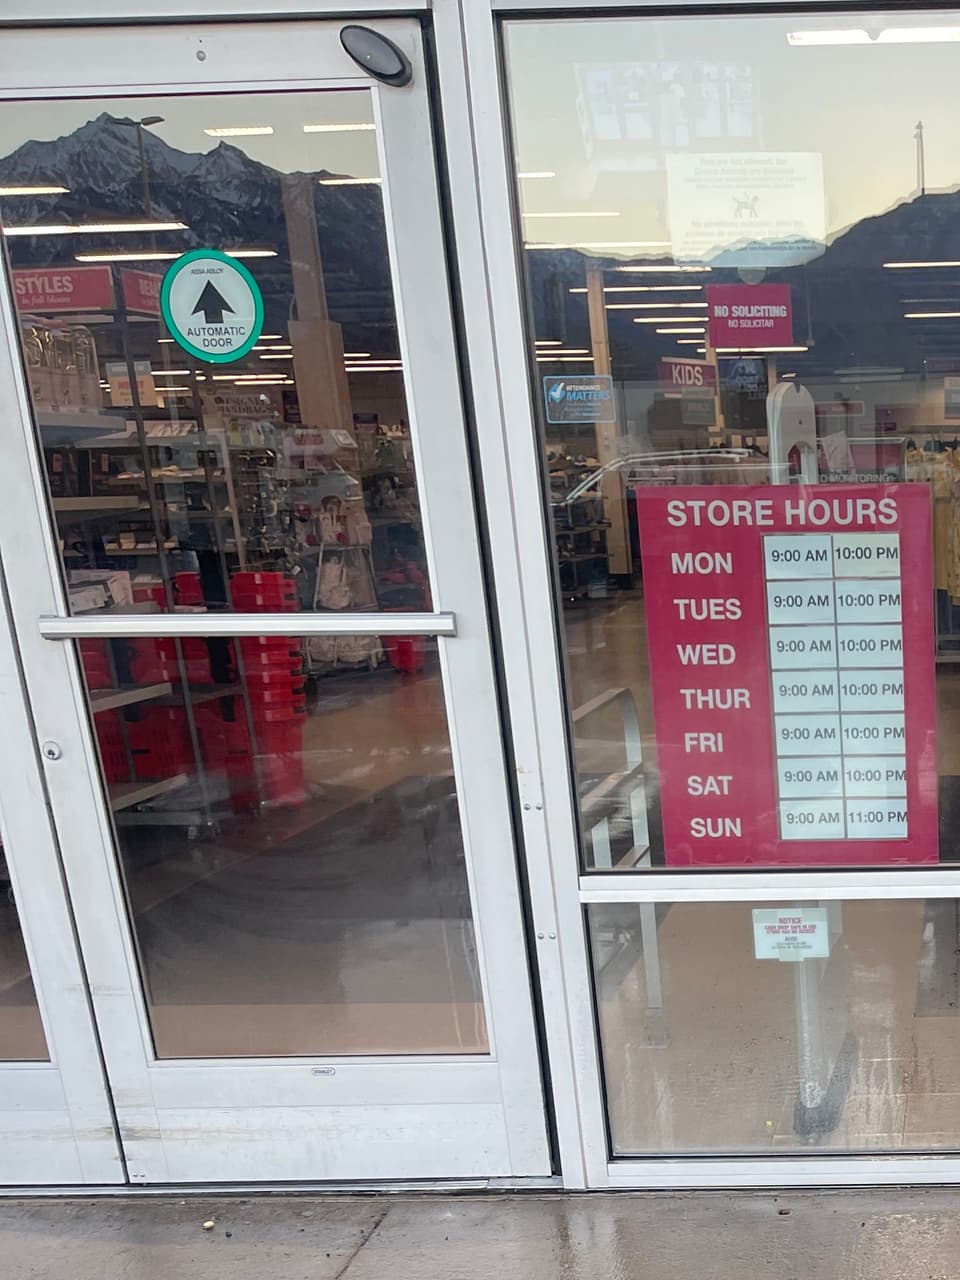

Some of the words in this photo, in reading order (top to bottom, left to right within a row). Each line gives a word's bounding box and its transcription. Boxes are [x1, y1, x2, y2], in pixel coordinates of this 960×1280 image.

[16, 276, 74, 294] STYLES
[714, 305, 729, 317] NO
[732, 305, 787, 317] SOLICITING
[187, 326, 246, 336] AUTOMATIC
[728, 320, 738, 328] NO
[203, 338, 233, 347] DOOR
[672, 364, 703, 385] KIDS
[667, 499, 774, 527] STORE
[785, 498, 898, 525] HOURS
[671, 552, 732, 574] MON
[771, 549, 800, 562] 9:00
[805, 549, 828, 561] AM
[835, 547, 872, 559] 10:00
[877, 546, 898, 558] PM
[673, 598, 742, 620] TUES
[774, 595, 803, 607] 9:00
[807, 595, 830, 606] AM
[838, 594, 874, 606] 10:00
[879, 594, 900, 605] PM
[676, 644, 736, 665] WED
[776, 640, 806, 652] 9:00
[809, 639, 832, 651] AM
[840, 639, 876, 651] 10:00
[880, 639, 902, 650] PM
[680, 688, 751, 709] THUR
[779, 685, 808, 696] 9:00
[812, 684, 834, 695] AM
[842, 684, 878, 695] 10:00
[882, 683, 903, 695] PM
[684, 732, 724, 752] FRI
[781, 728, 810, 739] 9:00
[814, 727, 836, 739] AM
[843, 727, 879, 739] 10:00
[884, 727, 905, 738] PM
[687, 775, 732, 796] SAT
[784, 771, 813, 782] 9:00
[816, 770, 839, 782] AM
[846, 770, 882, 781] 10:00
[886, 770, 907, 780] PM
[690, 817, 742, 838] SUN
[786, 813, 815, 824] 9:00
[818, 812, 840, 823] AM
[848, 812, 884, 823] 11:00
[888, 811, 908, 822] PM
